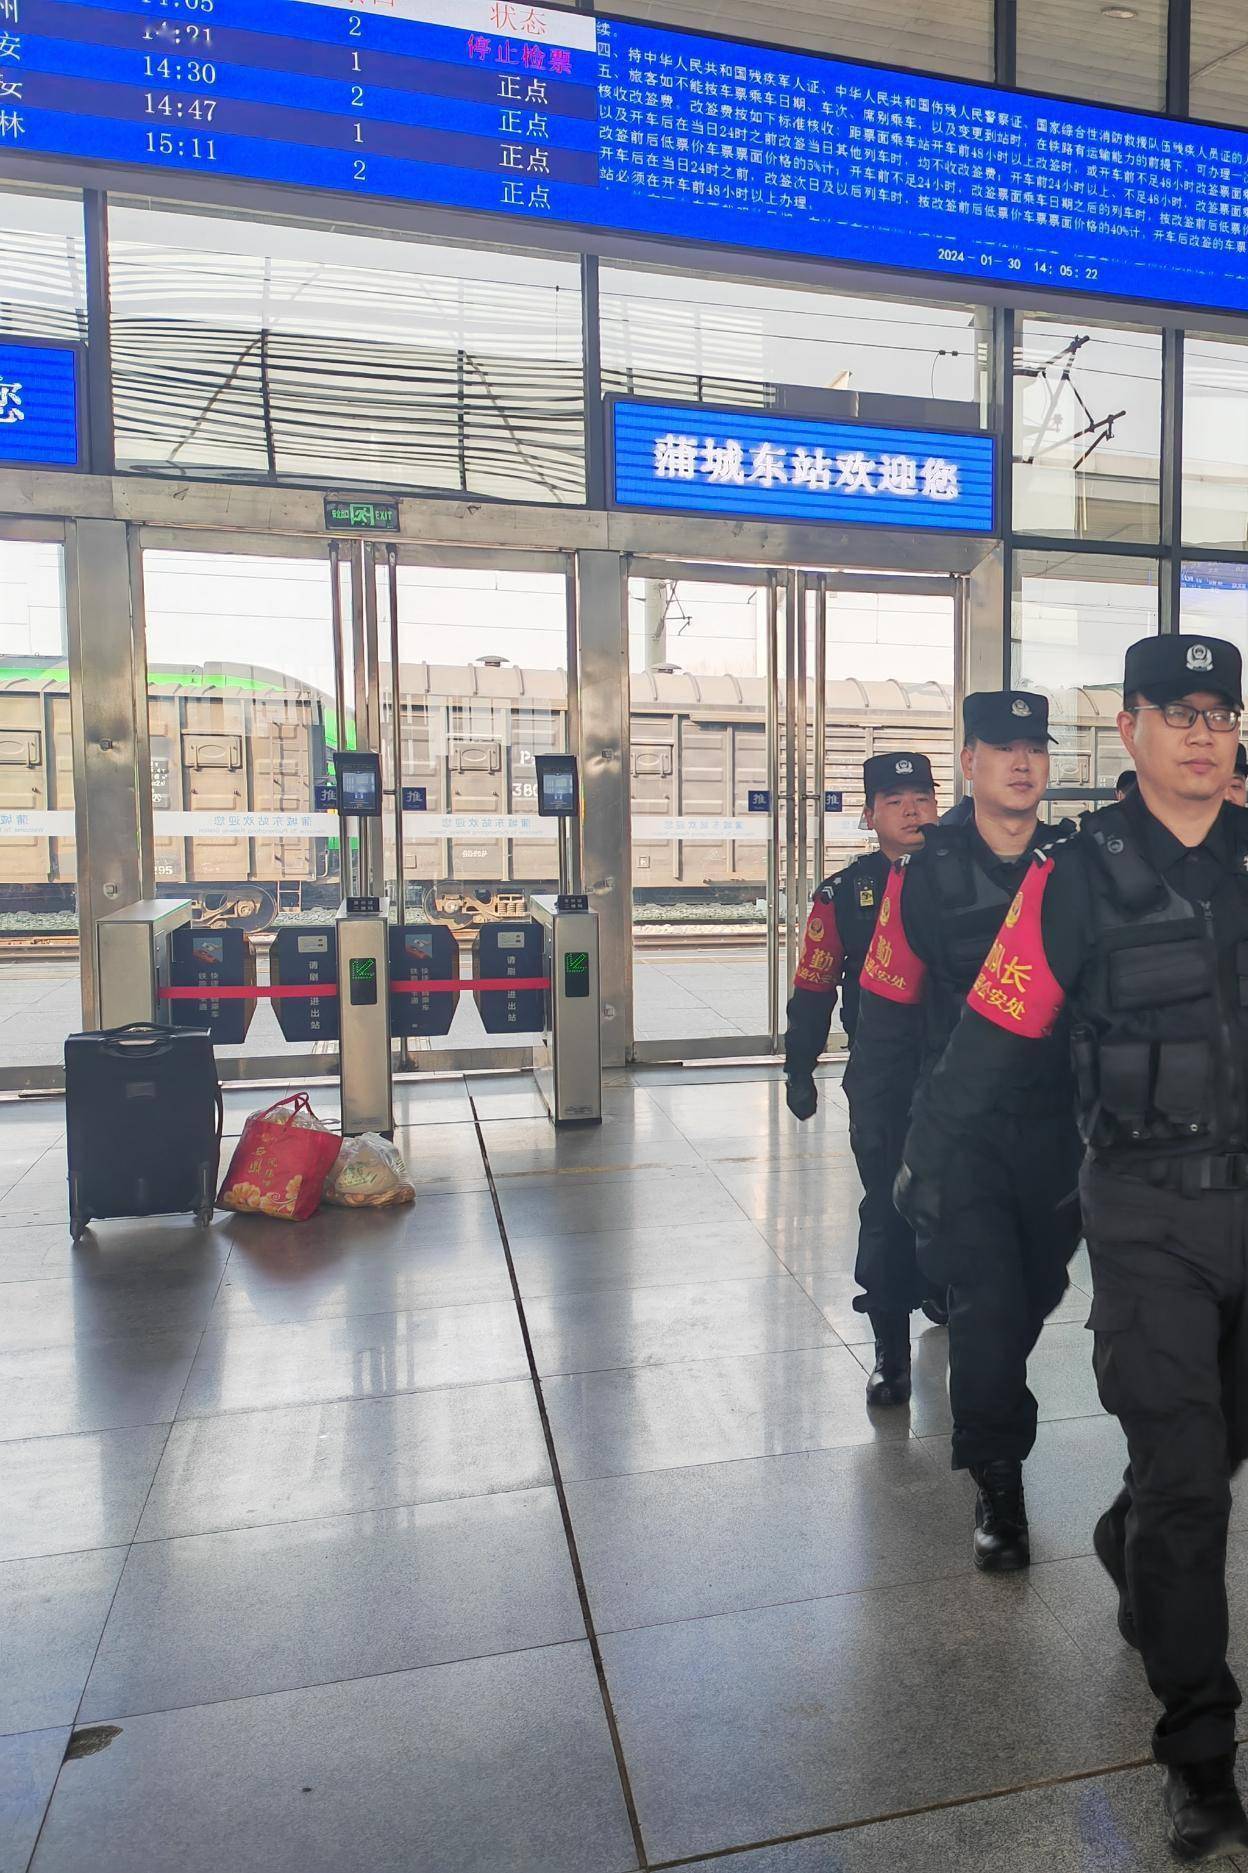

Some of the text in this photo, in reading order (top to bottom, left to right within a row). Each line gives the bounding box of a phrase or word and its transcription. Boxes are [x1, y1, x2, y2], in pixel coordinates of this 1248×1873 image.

[349, 16, 362, 37] 2
[490, 1, 546, 35] 状态
[351, 51, 362, 72] 1
[467, 34, 573, 75] 停止检票
[143, 55, 216, 85] 14:30
[351, 86, 364, 107] 2
[497, 74, 548, 105] 正点
[144, 93, 217, 122] 14:47
[353, 122, 364, 144] 1
[498, 110, 549, 140] 正点
[144, 132, 217, 161] 15:11
[499, 144, 551, 175] 正点
[352, 160, 366, 182] 2
[500, 180, 551, 211] 正点
[653, 434, 959, 500] 蒲城东站欢迎您
[375, 510, 393, 520] EXIT
[406, 791, 423, 802] 推
